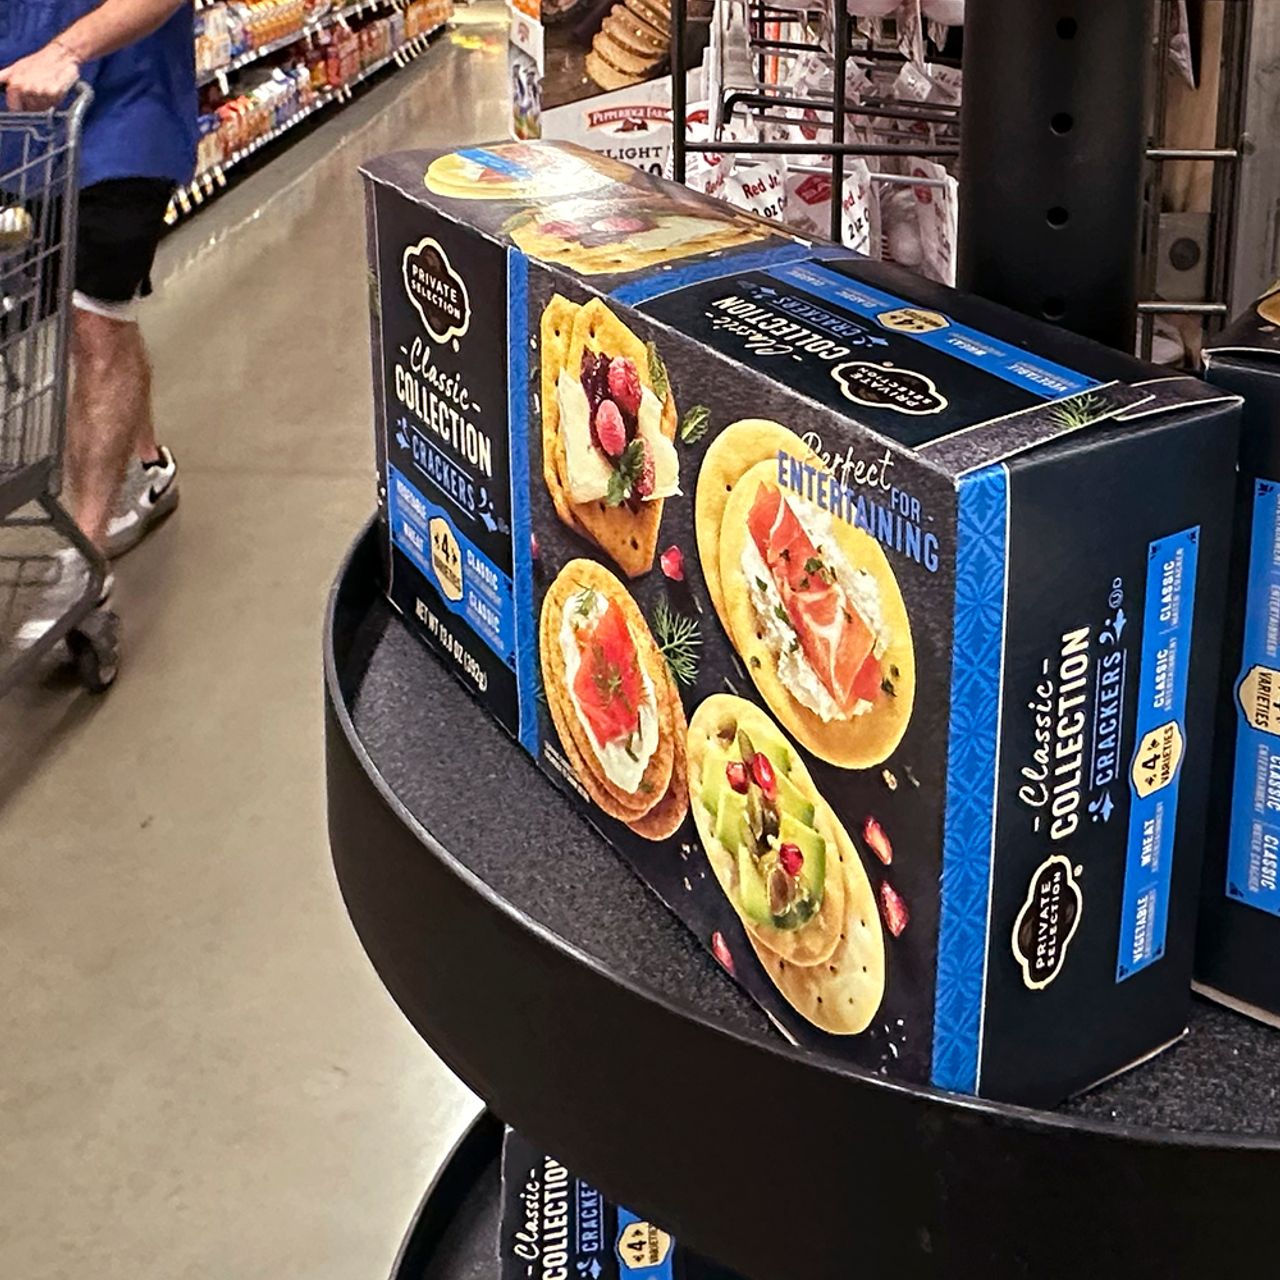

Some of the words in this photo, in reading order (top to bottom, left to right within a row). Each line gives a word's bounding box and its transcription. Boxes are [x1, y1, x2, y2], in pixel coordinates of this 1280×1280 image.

[410, 279, 461, 320] SELECTION
[411, 264, 458, 303] PRIVATE
[712, 295, 852, 363] COLLECTION
[395, 363, 493, 478] COLLECTION
[801, 431, 895, 492] Perfect
[411, 433, 476, 512] CRACKERS
[777, 449, 940, 573] ENTERTAINING
[891, 486, 921, 524] FOR
[1050, 624, 1092, 841] COLLECTION
[1094, 650, 1122, 787] CRACKERS
[1252, 670, 1274, 728] VARIETIES
[1019, 682, 1054, 810] Classic
[1035, 880, 1053, 970] PRIVATE
[1046, 870, 1062, 969] SELECTION
